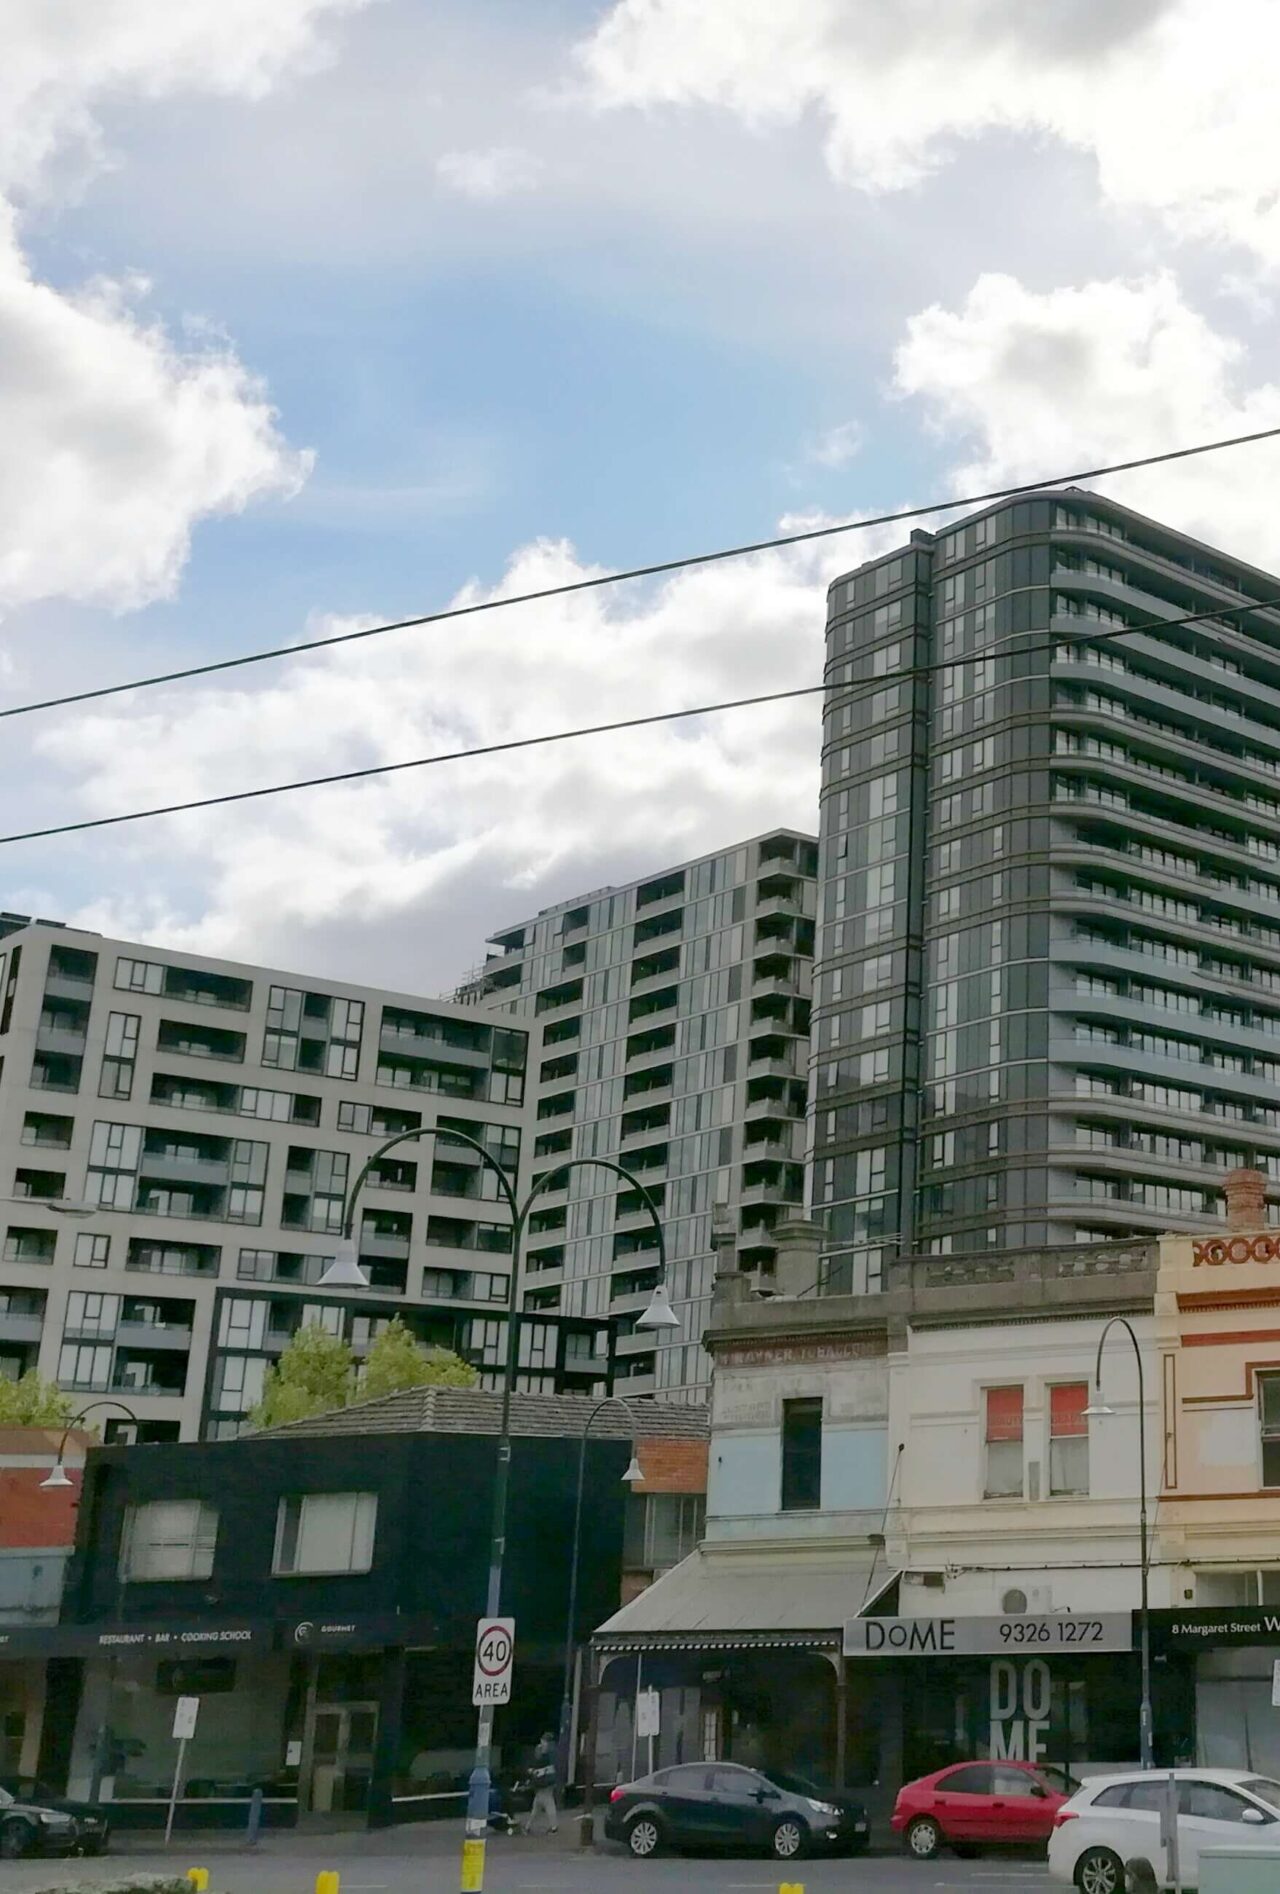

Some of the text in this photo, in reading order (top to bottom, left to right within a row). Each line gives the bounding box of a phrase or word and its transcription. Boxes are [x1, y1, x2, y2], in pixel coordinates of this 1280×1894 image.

[321, 1624, 356, 1633] GOURMET
[1000, 1622, 1050, 1644] 9326
[1057, 1621, 1103, 1642] 1272
[1172, 1624, 1179, 1634] 8
[1181, 1623, 1229, 1636] Margaret
[1230, 1622, 1261, 1633] Street
[99, 1630, 251, 1645] RESTAURANT BAR COOKING SCHOOL
[483, 1641, 507, 1661] 40
[475, 1682, 508, 1698] AREA
[990, 1660, 1051, 1720] DO
